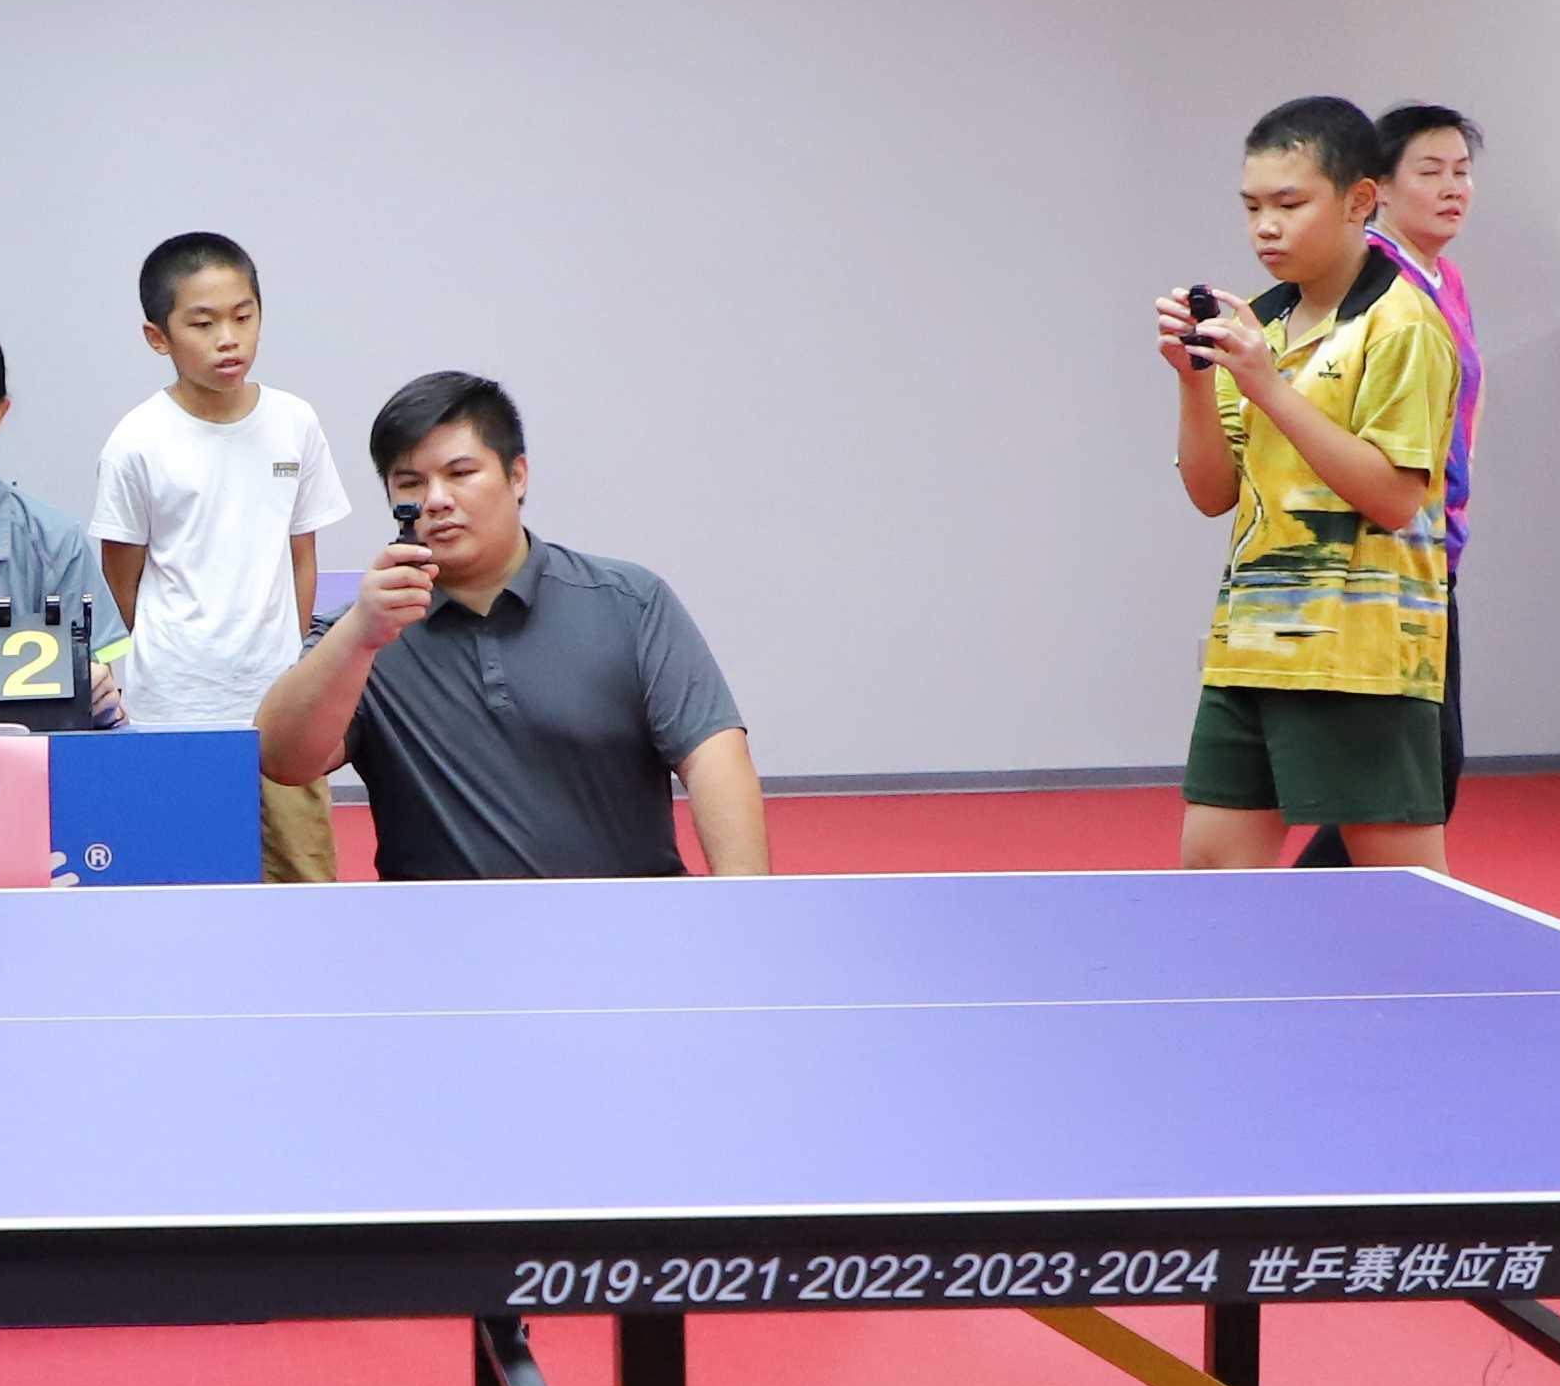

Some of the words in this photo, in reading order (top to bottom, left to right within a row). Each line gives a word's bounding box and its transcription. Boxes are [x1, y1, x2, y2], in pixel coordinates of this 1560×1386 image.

[2, 630, 61, 696] 2
[1247, 1241, 1553, 1293] 世乒赛供应商
